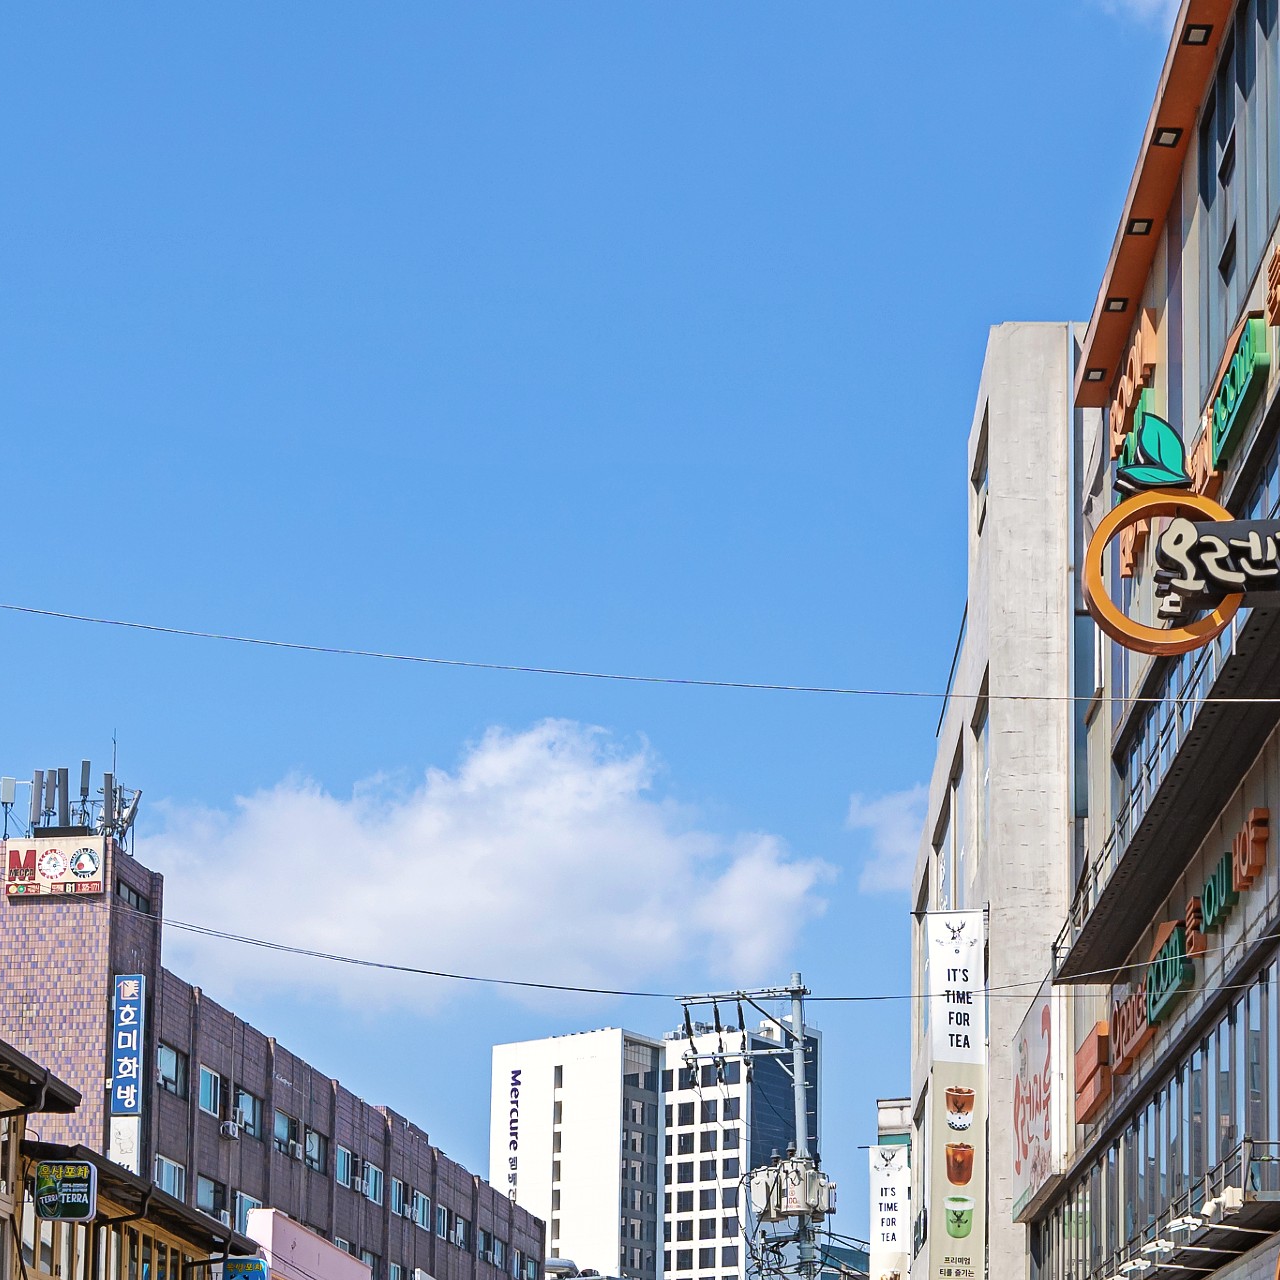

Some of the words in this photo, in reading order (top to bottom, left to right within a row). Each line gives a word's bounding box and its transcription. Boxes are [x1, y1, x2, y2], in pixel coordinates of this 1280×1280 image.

[1200, 852, 1238, 934] SOJU
[947, 968, 969, 982] IT'S
[945, 990, 973, 1004] TIME
[948, 1011, 970, 1026] FOR
[948, 1034, 970, 1048] TEA
[116, 1004, 140, 1108] 호미화방
[509, 1069, 522, 1151] Mercure
[38, 1164, 89, 1181] 옥상포차
[60, 1193, 89, 1204] TERRA
[880, 1187, 896, 1197] IT'S
[879, 1202, 898, 1212] TIME
[881, 1218, 897, 1227] FOR
[882, 1233, 897, 1242] TEA
[943, 1256, 971, 1265] 프리미엄
[940, 1268, 952, 1277] 티를
[955, 1268, 975, 1277] 즐기는
